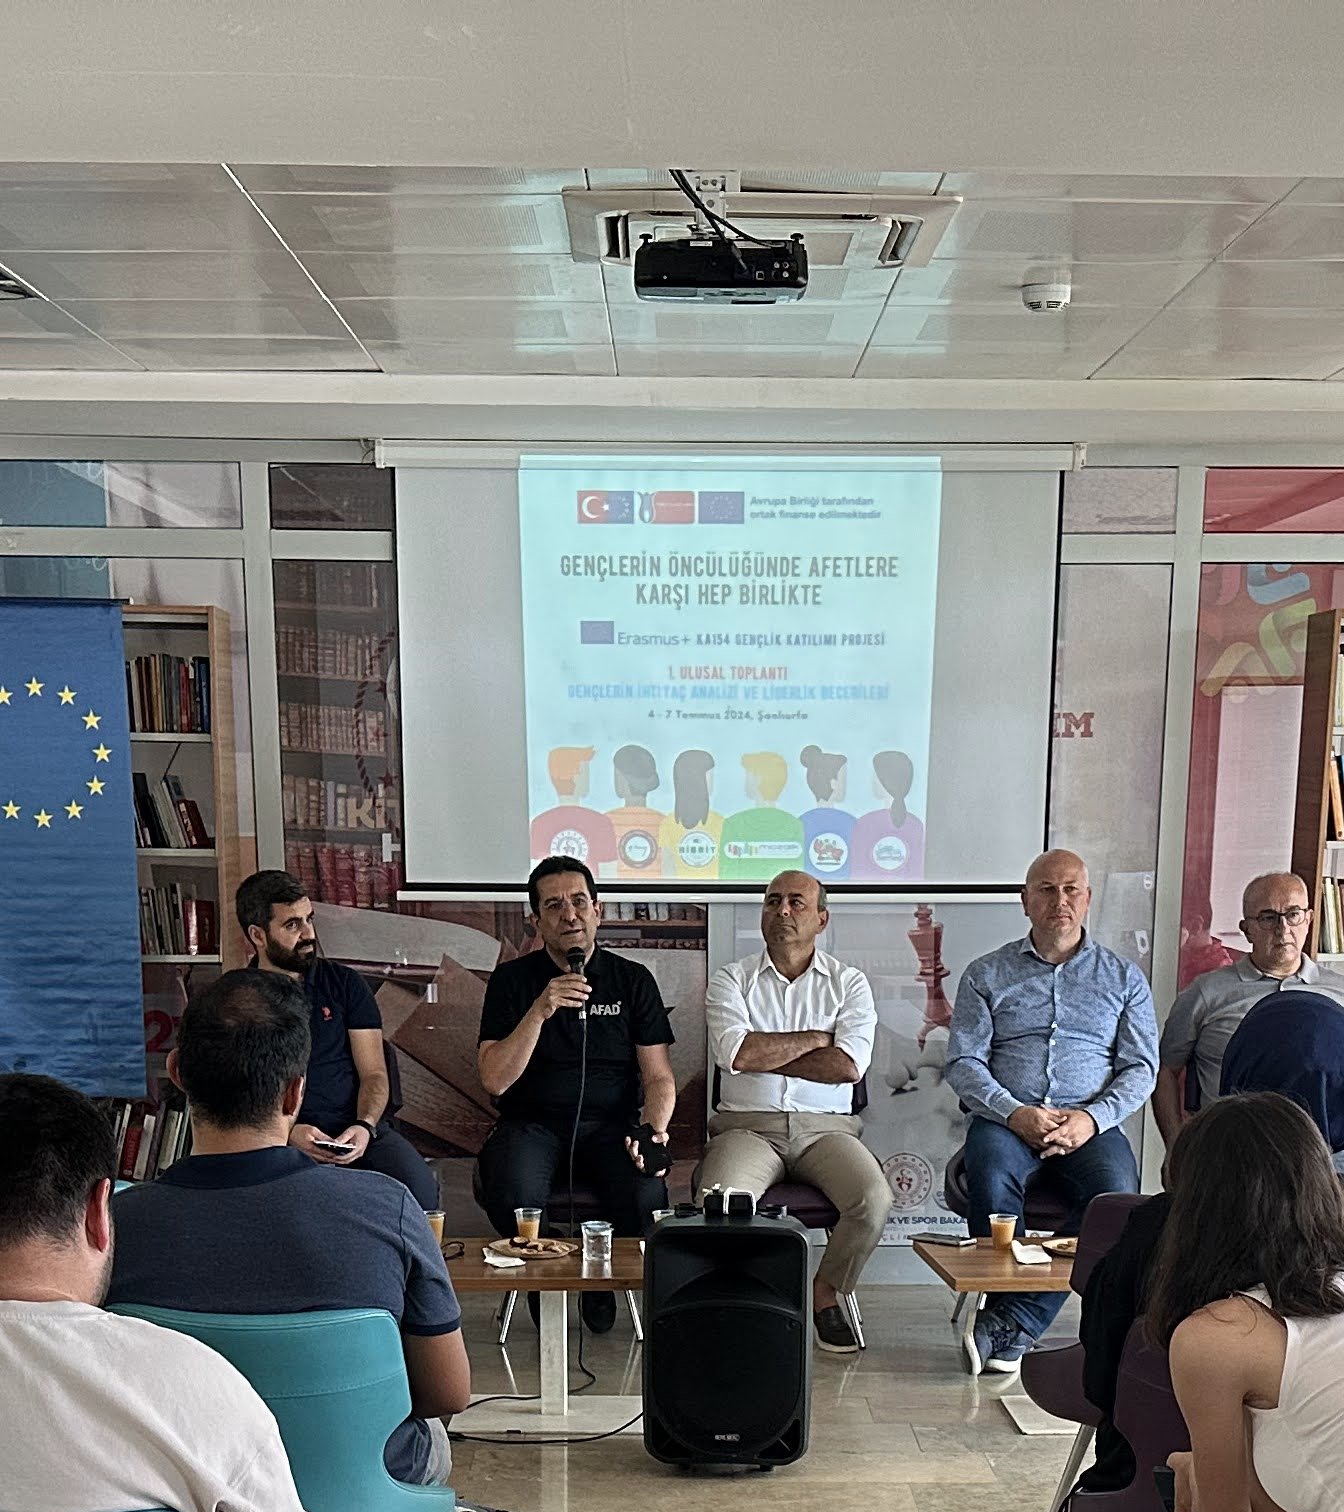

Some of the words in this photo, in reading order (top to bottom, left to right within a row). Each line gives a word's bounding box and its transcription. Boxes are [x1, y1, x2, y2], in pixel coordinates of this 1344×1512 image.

[560, 551, 661, 583] GENÇLERİN
[668, 550, 801, 578] ÖNCÜLÜĞÜNDE
[808, 556, 899, 578] AFETLERE
[636, 583, 690, 610] KARŞI
[698, 583, 731, 605] HEP
[739, 580, 823, 606] BİRLİKTE
[696, 633, 730, 646] KA154
[735, 632, 781, 648] GENÇLİK
[786, 633, 836, 646] KATILIMI
[841, 631, 885, 646] PROJESİ
[680, 666, 725, 680] ULUSAL
[730, 666, 788, 680] TOPLANTI
[589, 1003, 622, 1016] AFAD
[911, 1216, 938, 1224] SPOR
